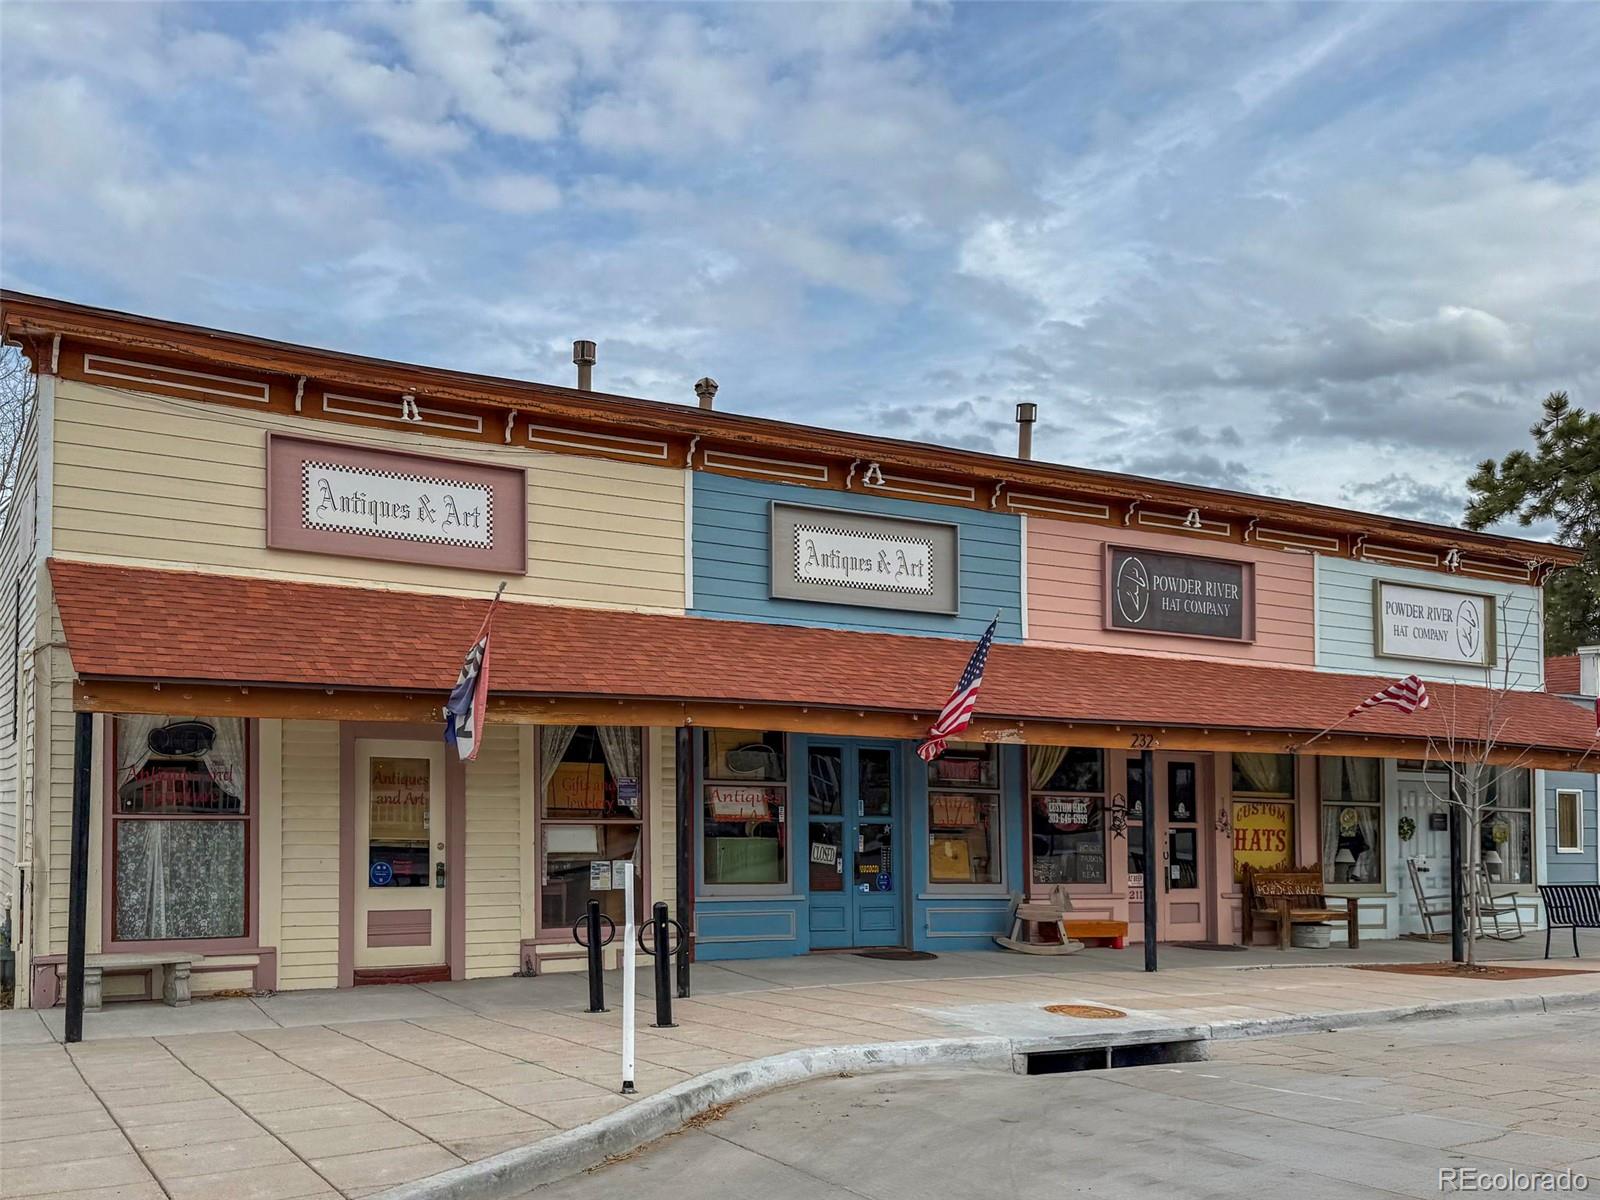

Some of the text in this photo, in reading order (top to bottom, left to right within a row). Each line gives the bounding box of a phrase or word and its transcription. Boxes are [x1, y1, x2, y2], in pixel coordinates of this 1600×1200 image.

[315, 478, 481, 534] Antiques & Art
[804, 538, 924, 583] Antiques & Art
[1153, 575, 1239, 600] POWDER RIVER
[1162, 597, 1231, 617] HAT COMPANY
[1385, 601, 1454, 623] POWDER RIVER
[1393, 624, 1449, 642] HAT COMPANY
[1131, 733, 1154, 748] 232
[373, 770, 429, 790] Antiques
[376, 789, 425, 805] and Art
[1236, 803, 1286, 823] CUSTOM
[1233, 828, 1287, 852] HATS
[812, 845, 836, 864] CLOSED
[1129, 890, 1143, 900] 211
